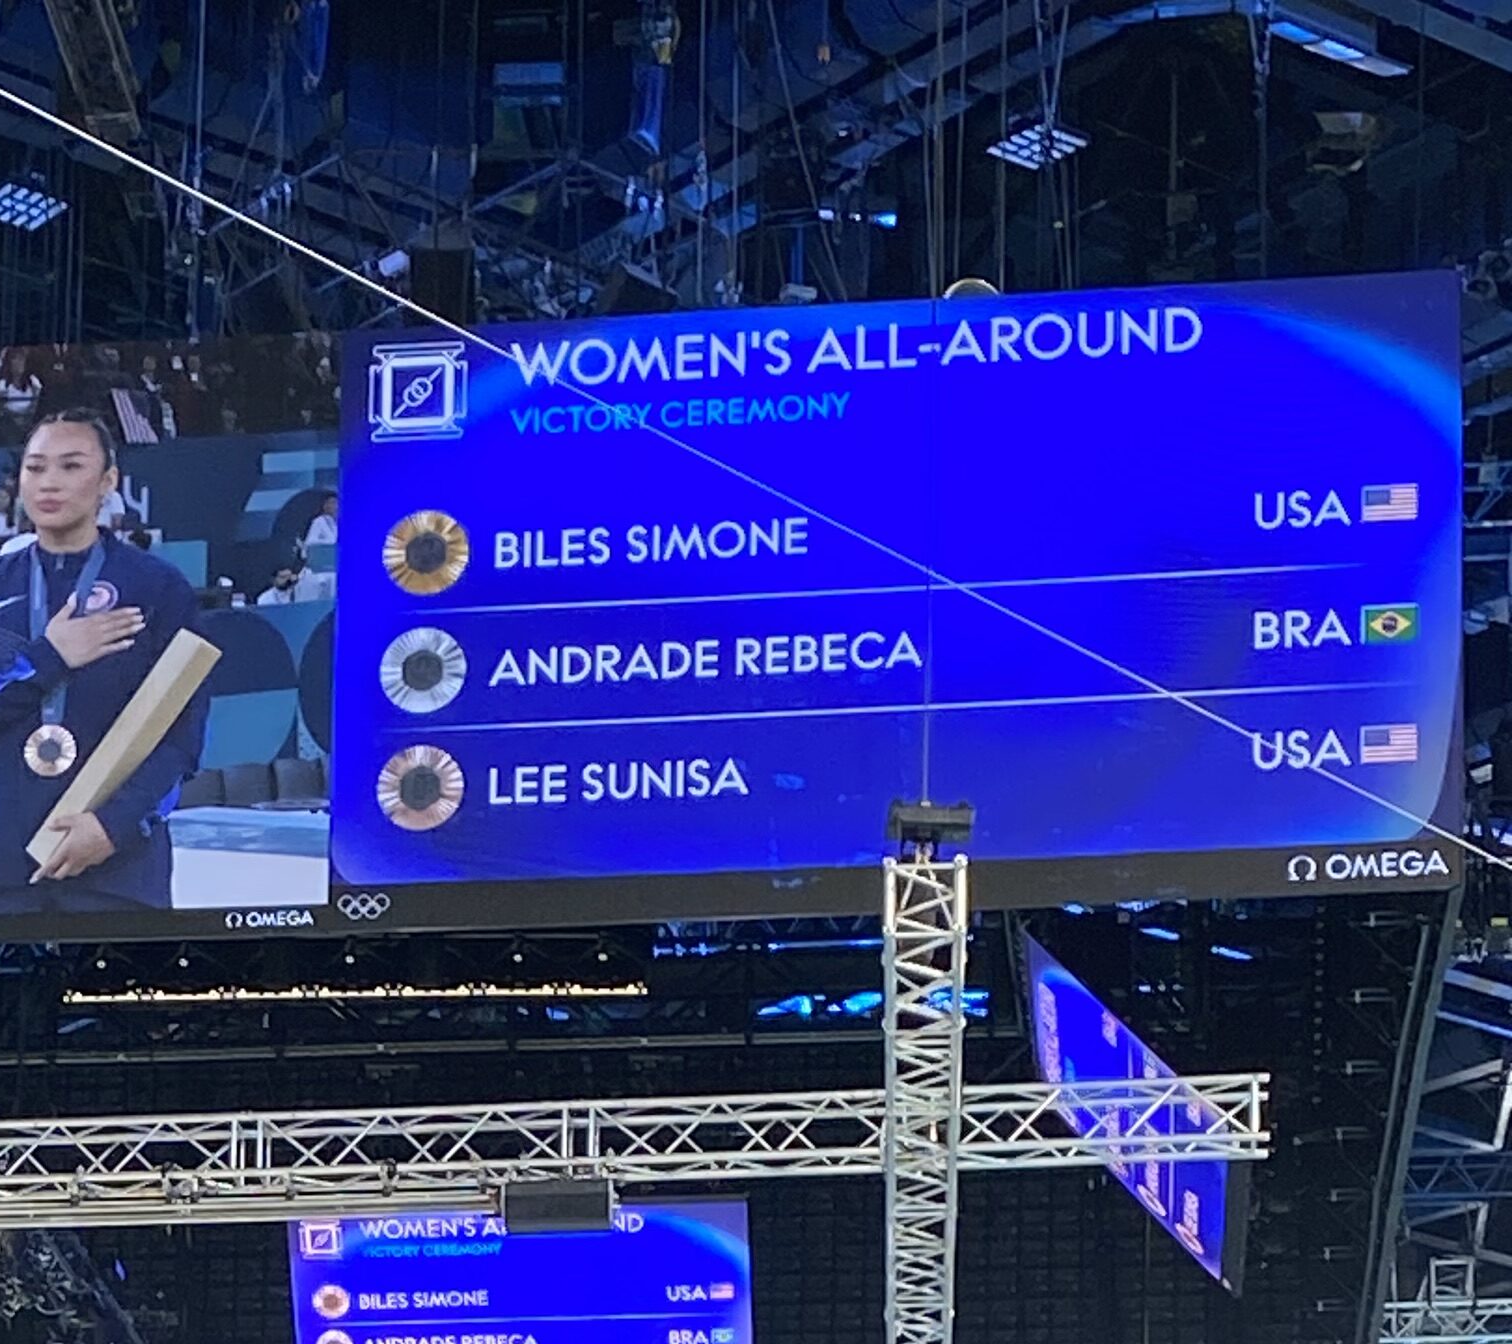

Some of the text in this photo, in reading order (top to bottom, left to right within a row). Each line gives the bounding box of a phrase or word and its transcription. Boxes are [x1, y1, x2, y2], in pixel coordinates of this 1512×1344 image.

[510, 307, 1203, 385] WOMEN'S ALL-AROUND
[509, 392, 851, 434] VICTORY CEREMONY
[1254, 489, 1351, 530] USA
[493, 518, 808, 568] BILES SIMONE
[1254, 608, 1352, 650] BRA
[489, 631, 922, 686] ANDRADE REBECA
[1252, 728, 1351, 770] USA
[489, 757, 749, 804] LEE SUNISA
[1326, 849, 1449, 879] OMEGA
[246, 910, 314, 928] OMEGA
[359, 1217, 476, 1239] WOMEN'S
[358, 1289, 489, 1310] BILES SIMONE
[666, 1285, 706, 1302] USA
